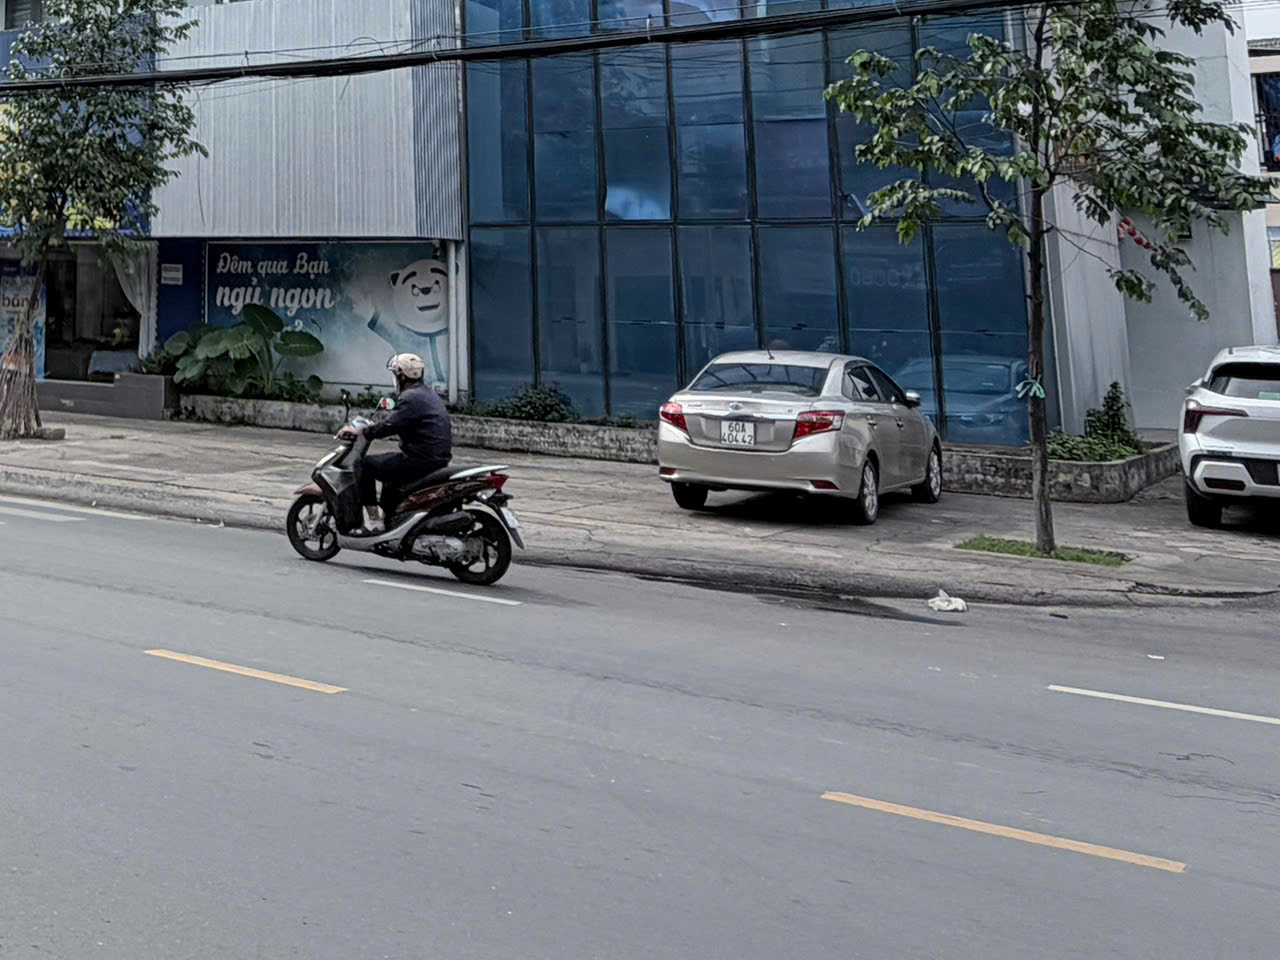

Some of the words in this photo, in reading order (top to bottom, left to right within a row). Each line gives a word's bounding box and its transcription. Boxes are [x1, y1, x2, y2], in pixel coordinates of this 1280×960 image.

[216, 252, 254, 274] Đêm
[258, 260, 289, 278] qua
[293, 252, 331, 279] Bạn
[216, 277, 264, 315] ngủ
[271, 287, 336, 316] ngon
[728, 421, 746, 433] 60A
